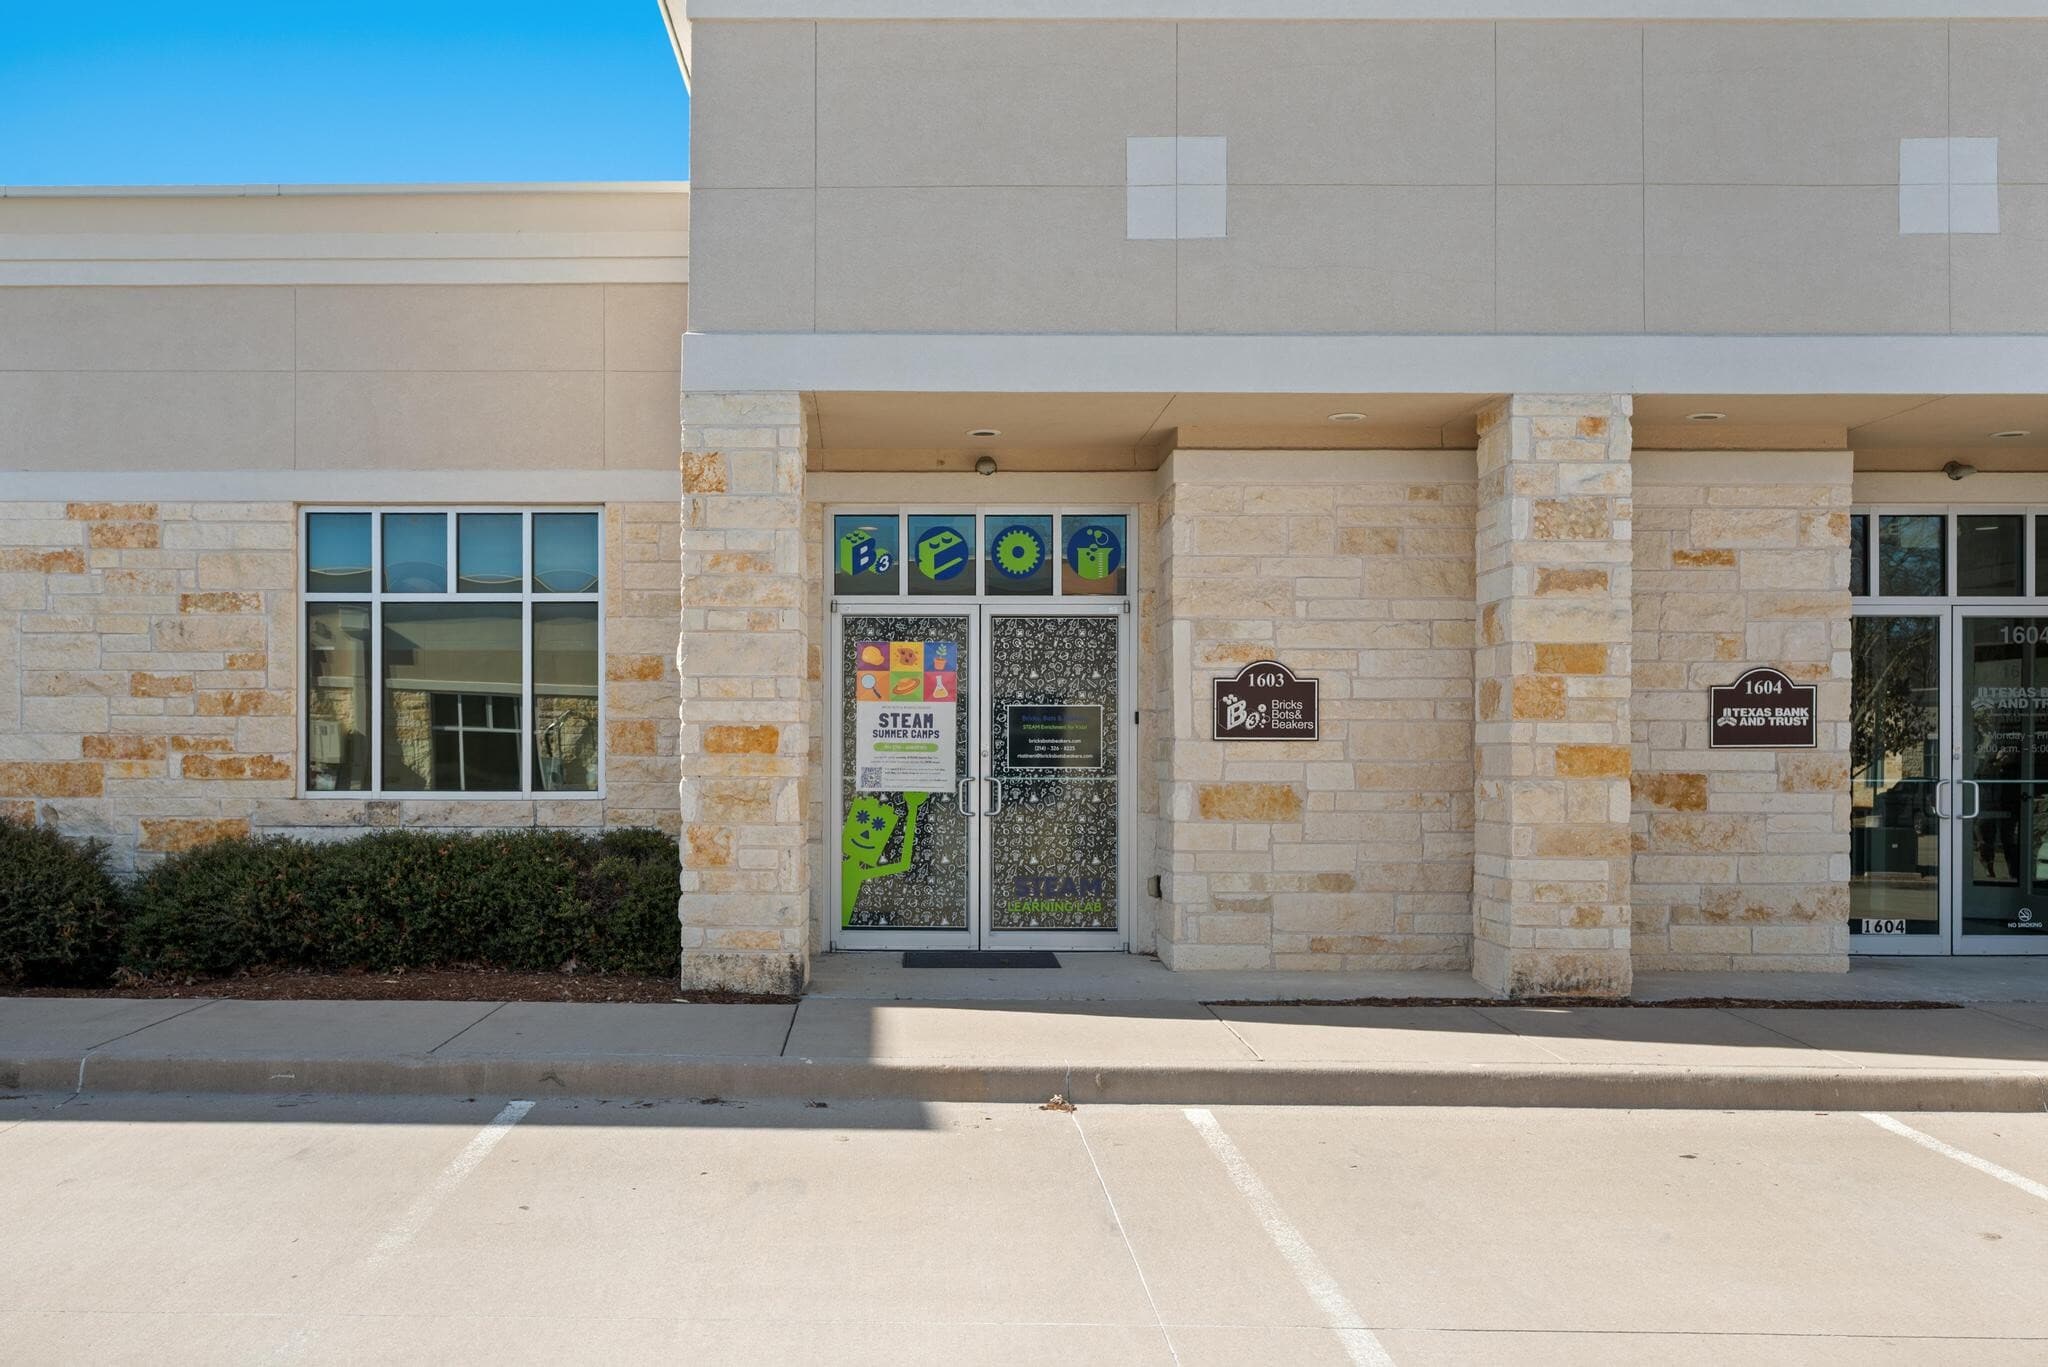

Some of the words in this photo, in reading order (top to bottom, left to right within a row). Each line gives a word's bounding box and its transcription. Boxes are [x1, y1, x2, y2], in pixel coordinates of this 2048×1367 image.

[2000, 626, 2048, 644] 1604
[1248, 673, 1285, 687] 1603
[1745, 680, 1783, 694] 1604
[1988, 687, 2036, 698] TEXAS
[1271, 699, 1303, 710] Bricks
[1998, 698, 2028, 709] AND
[1732, 707, 1772, 717] TEXAS
[1775, 707, 1809, 717] BANK
[878, 712, 934, 729] STEAM
[1271, 720, 1314, 730] Beakers
[1739, 716, 1766, 726] AND
[1768, 716, 1809, 726] TRUST
[872, 729, 909, 739] SUMMER
[911, 729, 940, 739] CAMPS
[1990, 730, 2026, 742] Monday
[1014, 876, 1102, 898] STEAM
[1007, 901, 1074, 912] LEARNING
[1077, 901, 1102, 912] LAB
[1864, 920, 1905, 934] 1604
